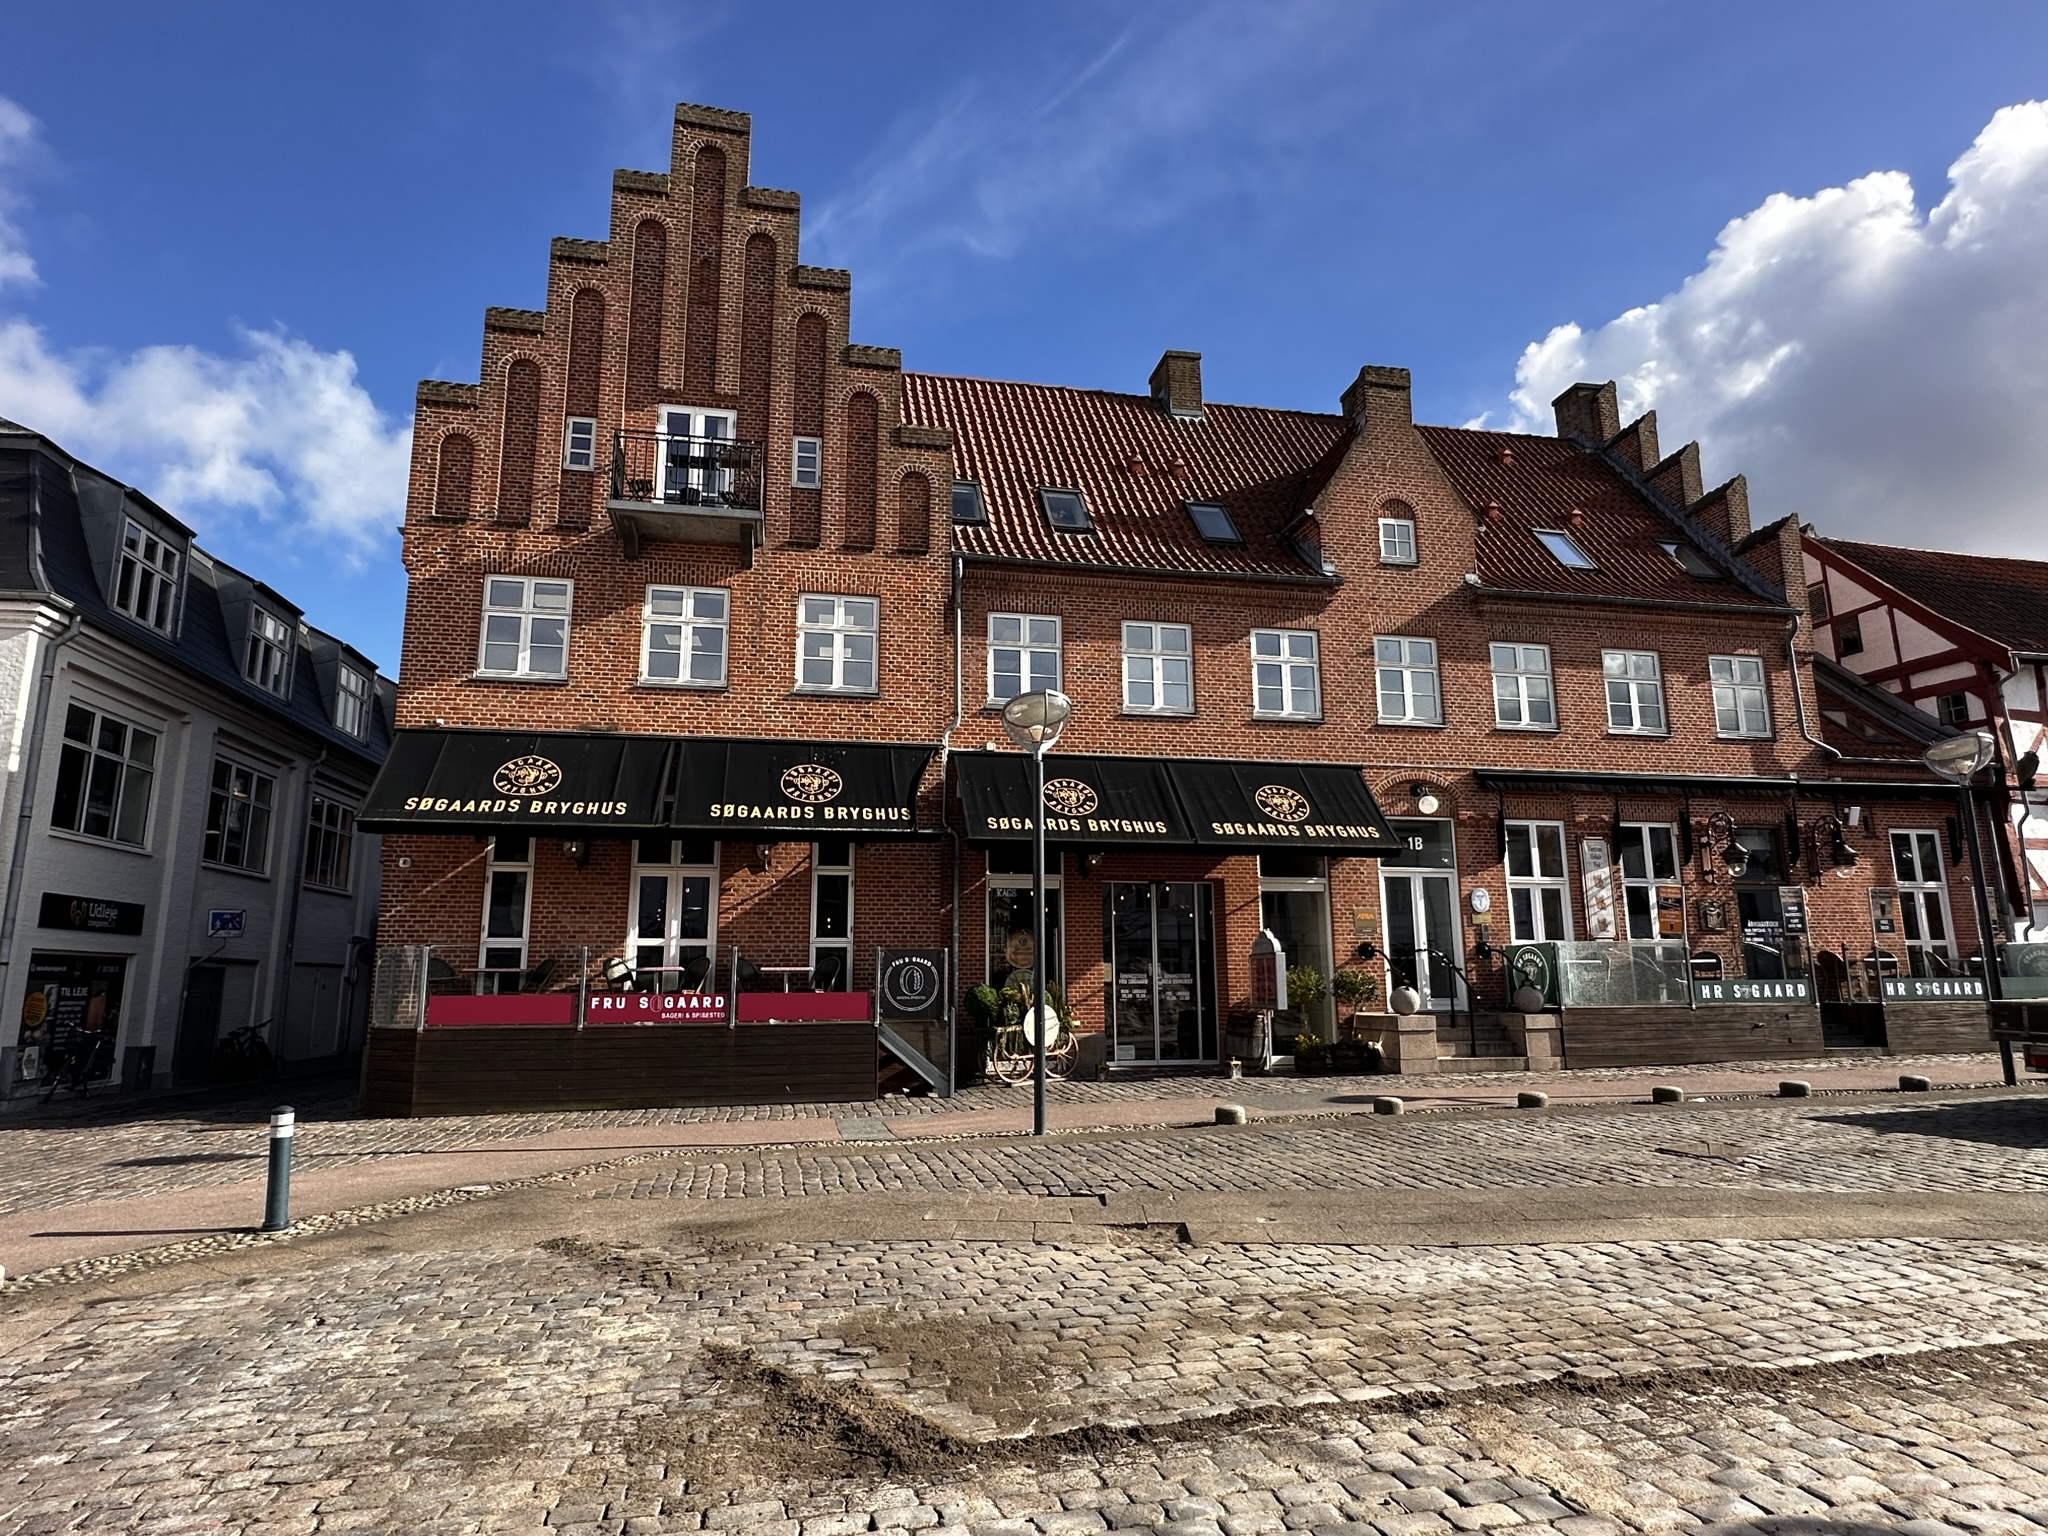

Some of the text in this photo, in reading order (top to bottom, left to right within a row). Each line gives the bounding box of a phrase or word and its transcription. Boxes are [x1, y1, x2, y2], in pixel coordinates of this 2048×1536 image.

[404, 797, 628, 816] SØGAARDS BRYGHUS
[710, 804, 911, 820] SØGAARDS BRYGHUS
[987, 817, 1167, 834] SØGARDS BRYGHUS
[1211, 821, 1380, 839] SØGAARDS BRYGHUS
[1407, 836, 1423, 851] 1B
[89, 903, 117, 922] Udleje
[1701, 984, 1723, 999] HR
[1885, 982, 1906, 996] HR
[591, 996, 626, 1009] FRU
